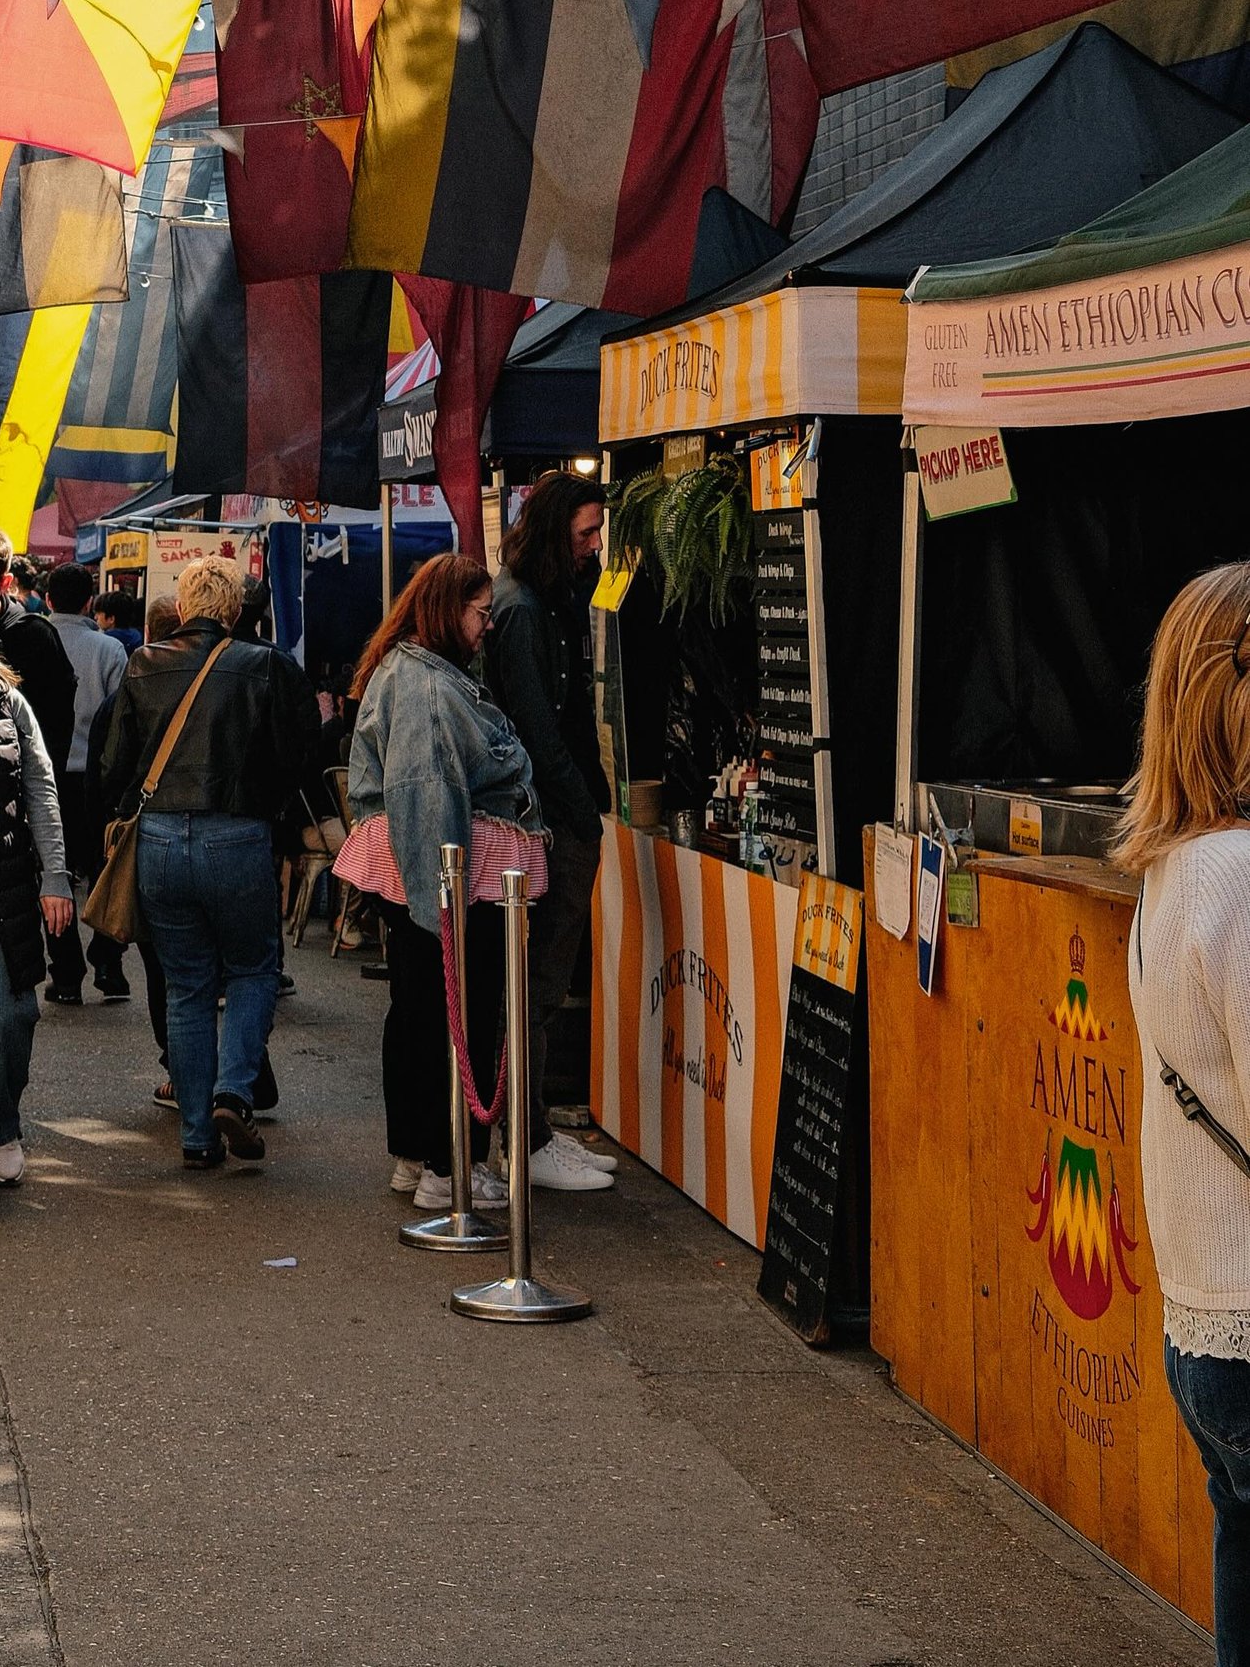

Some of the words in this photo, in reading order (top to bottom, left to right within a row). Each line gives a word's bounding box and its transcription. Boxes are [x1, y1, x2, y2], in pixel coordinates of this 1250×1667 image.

[924, 323, 968, 350] GLUTEN
[984, 302, 1052, 358] AMEN
[1058, 275, 1206, 352] ETHIOPIAN
[641, 346, 671, 413] DUCK
[674, 340, 720, 401] FRITES
[932, 362, 958, 388] FREE
[757, 442, 779, 469] DUCK
[919, 446, 960, 484] PICKUP
[961, 435, 1003, 475] HERE
[161, 547, 203, 563] SAM'S
[1012, 834, 1021, 846] Hot
[1021, 834, 1039, 850] surface
[802, 903, 824, 923] DUCK
[825, 905, 854, 944] FRITES
[651, 949, 687, 1016] DUCK
[689, 950, 744, 1066] FRITES
[686, 1045, 701, 1085] need
[708, 1053, 726, 1103] Duck
[1030, 1039, 1126, 1146] AMEN
[1032, 1288, 1141, 1404] ETHIOPIAN
[1057, 1386, 1115, 1448] CUISINES
